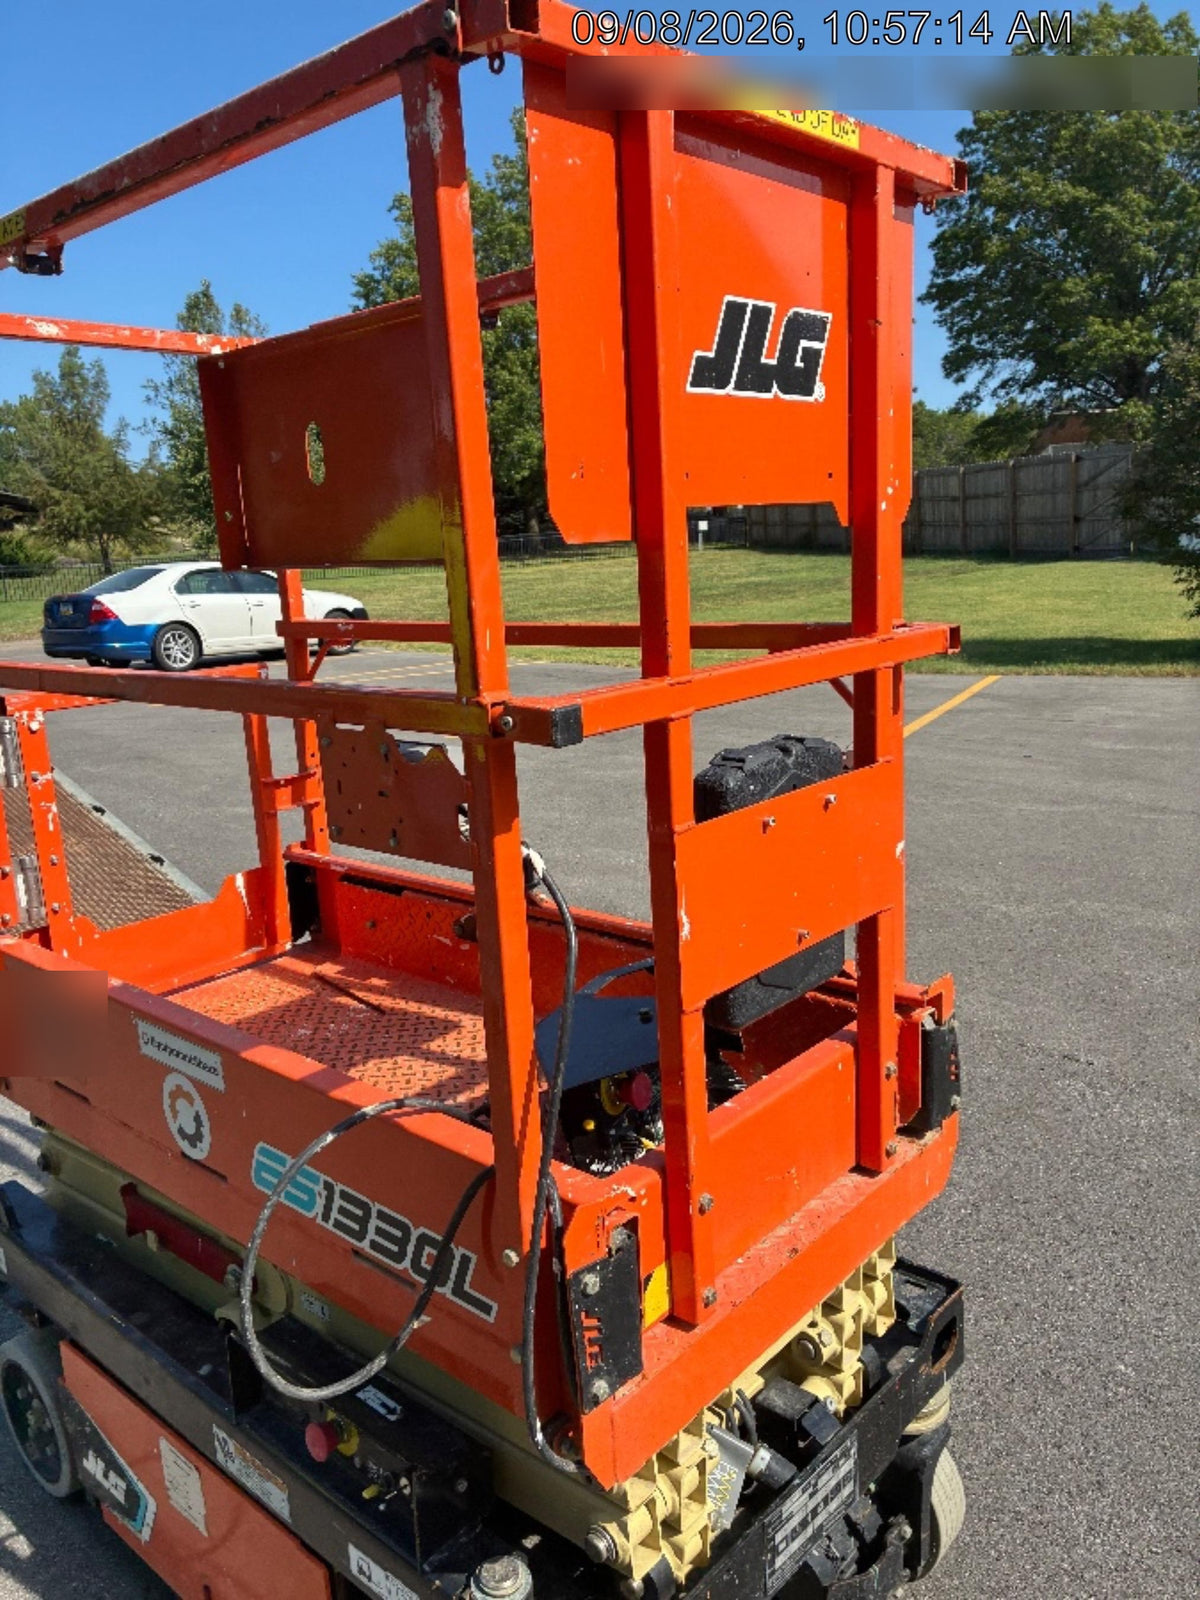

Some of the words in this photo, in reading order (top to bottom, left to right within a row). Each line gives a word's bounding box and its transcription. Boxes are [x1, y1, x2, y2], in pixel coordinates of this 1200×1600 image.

[686, 294, 832, 403] JLG
[251, 1141, 498, 1323] ES1330L
[82, 1449, 127, 1505] JLG
